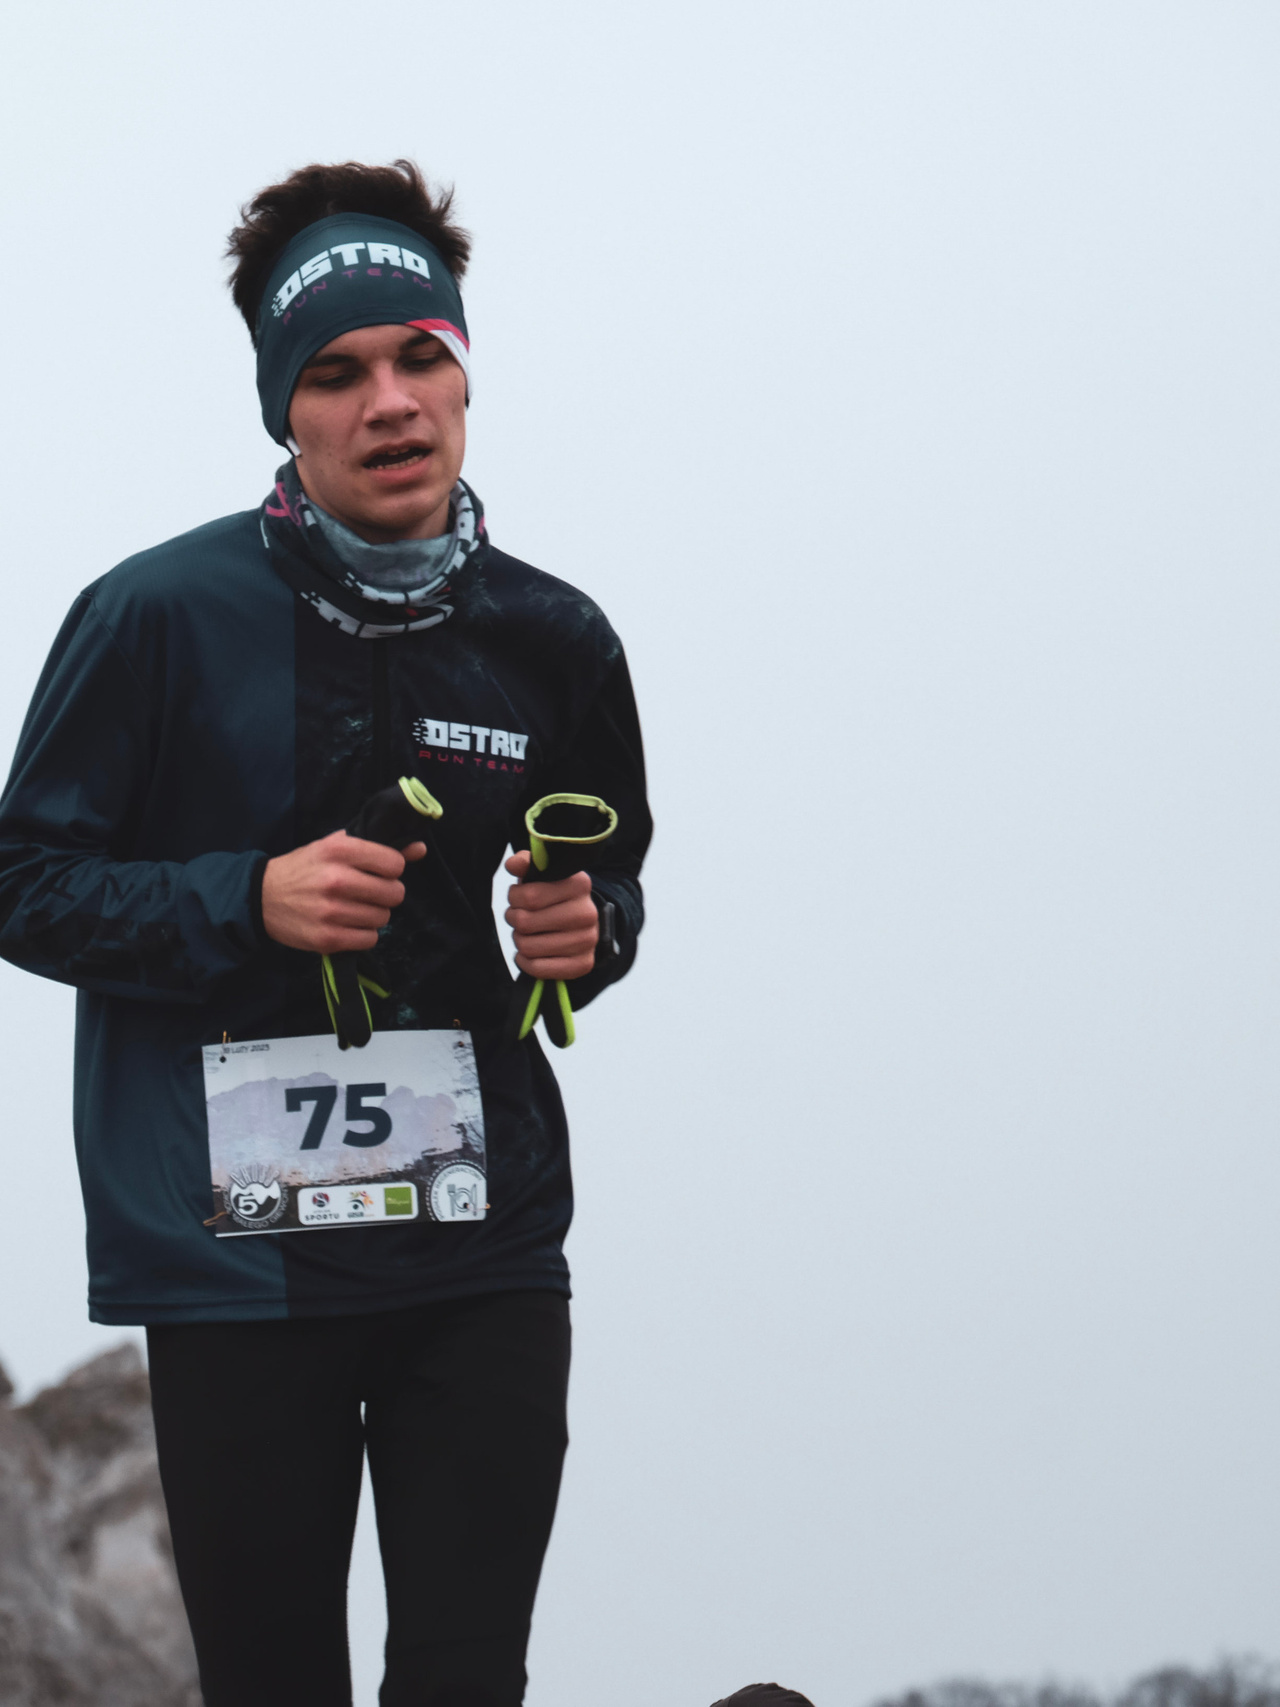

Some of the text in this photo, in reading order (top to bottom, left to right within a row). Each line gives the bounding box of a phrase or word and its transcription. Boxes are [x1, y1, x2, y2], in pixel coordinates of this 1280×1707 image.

[273, 242, 431, 316] OSTRO
[283, 268, 433, 325] RUN TEAM
[414, 718, 529, 761] OSTRO
[418, 750, 525, 774] RUN TEAM
[285, 1082, 393, 1152] 75
[238, 1194, 259, 1216] 5
[304, 1212, 340, 1222] SPORTU
